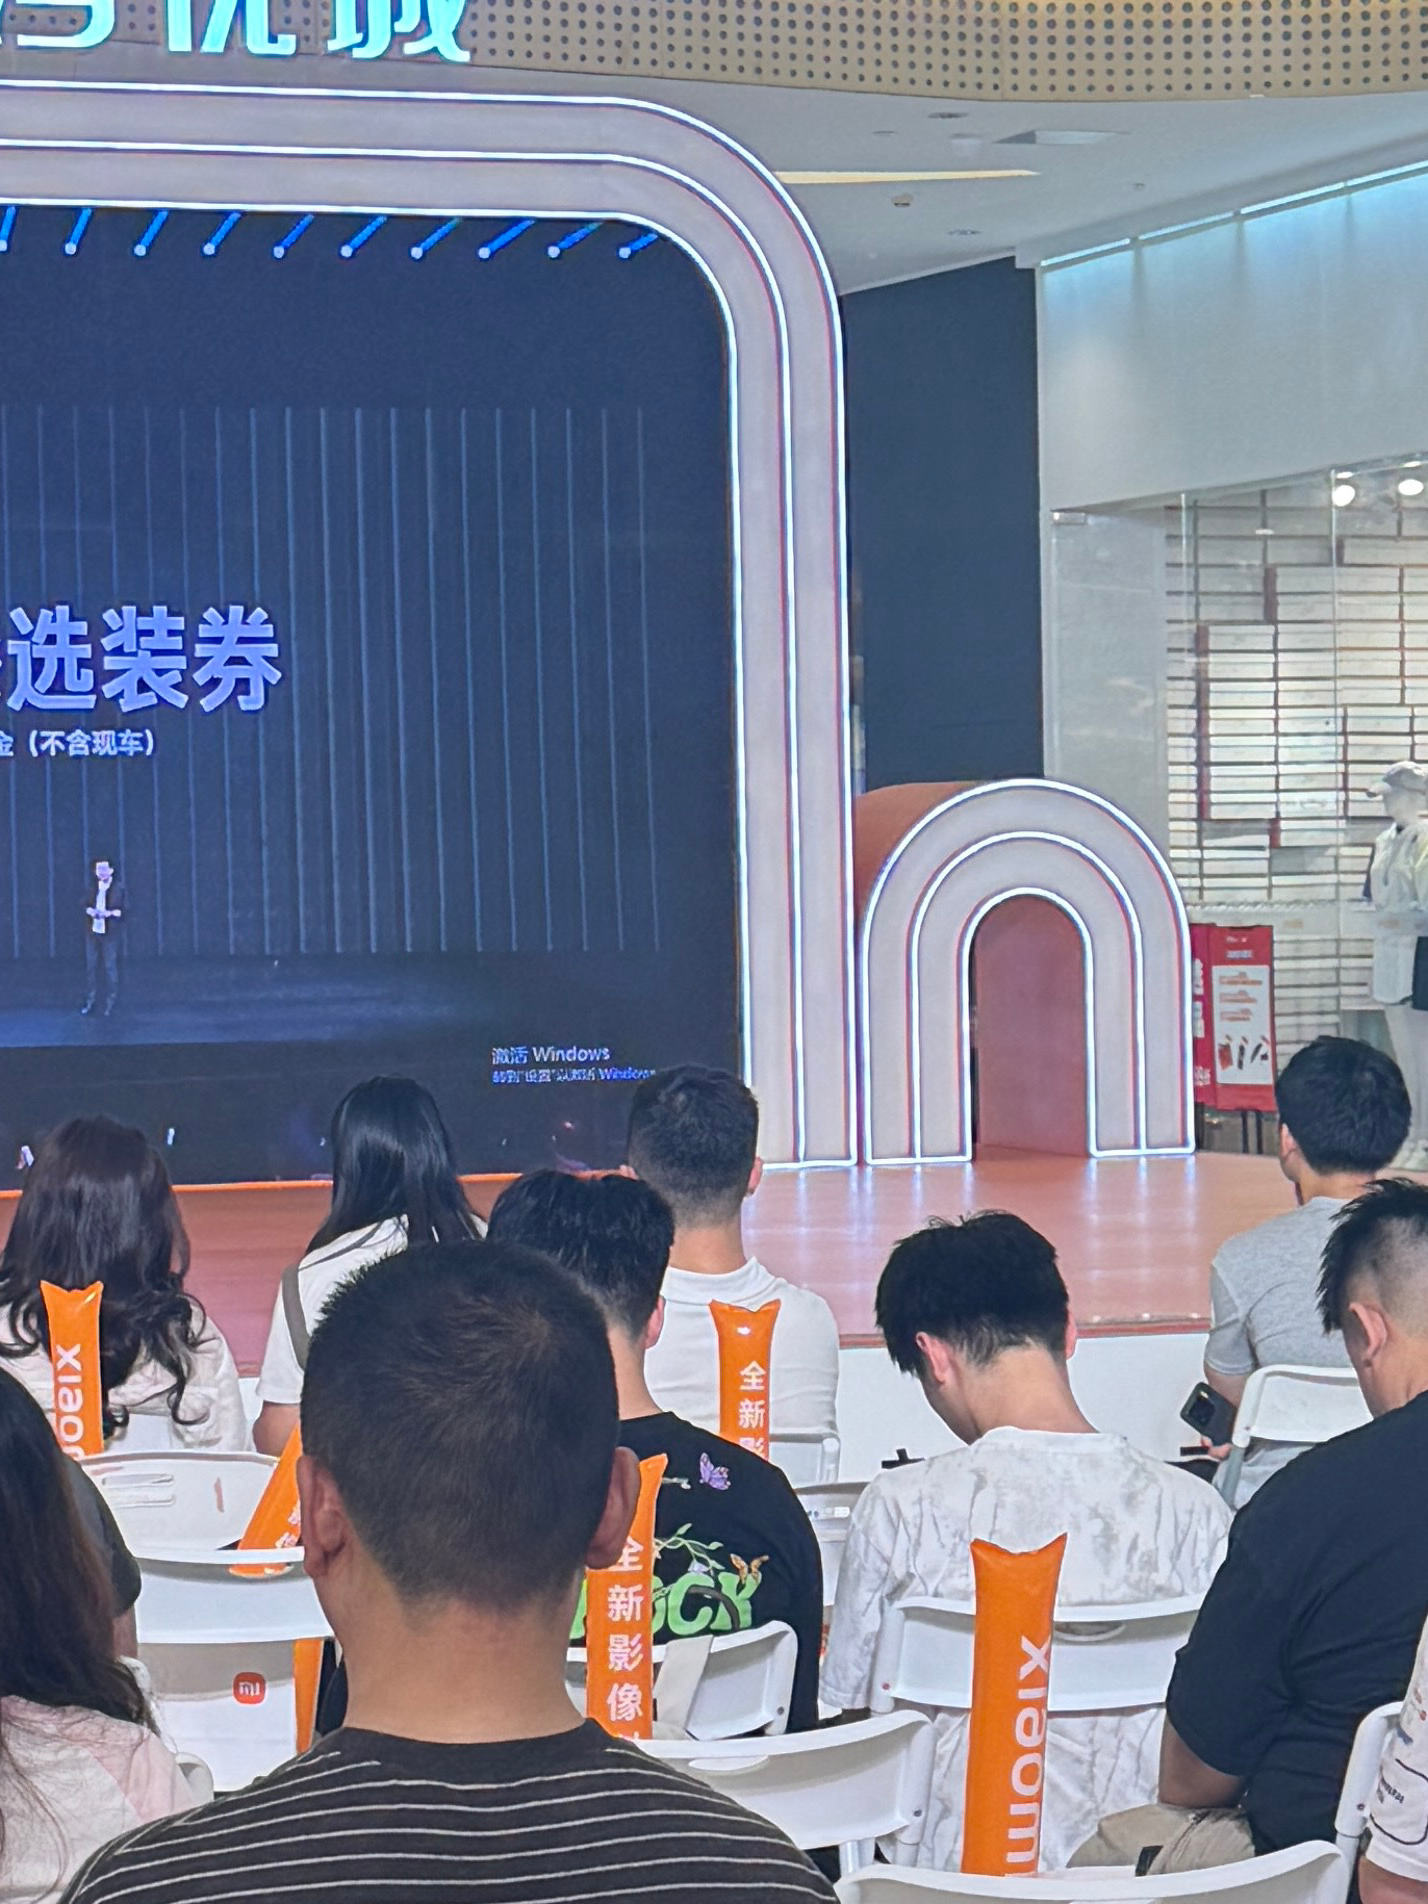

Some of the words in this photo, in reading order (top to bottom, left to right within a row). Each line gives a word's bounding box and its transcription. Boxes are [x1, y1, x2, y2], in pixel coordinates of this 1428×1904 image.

[532, 1046, 610, 1062] Windows
[607, 1538, 644, 1740] 全新影像
[1005, 1636, 1051, 1878] xiaom
